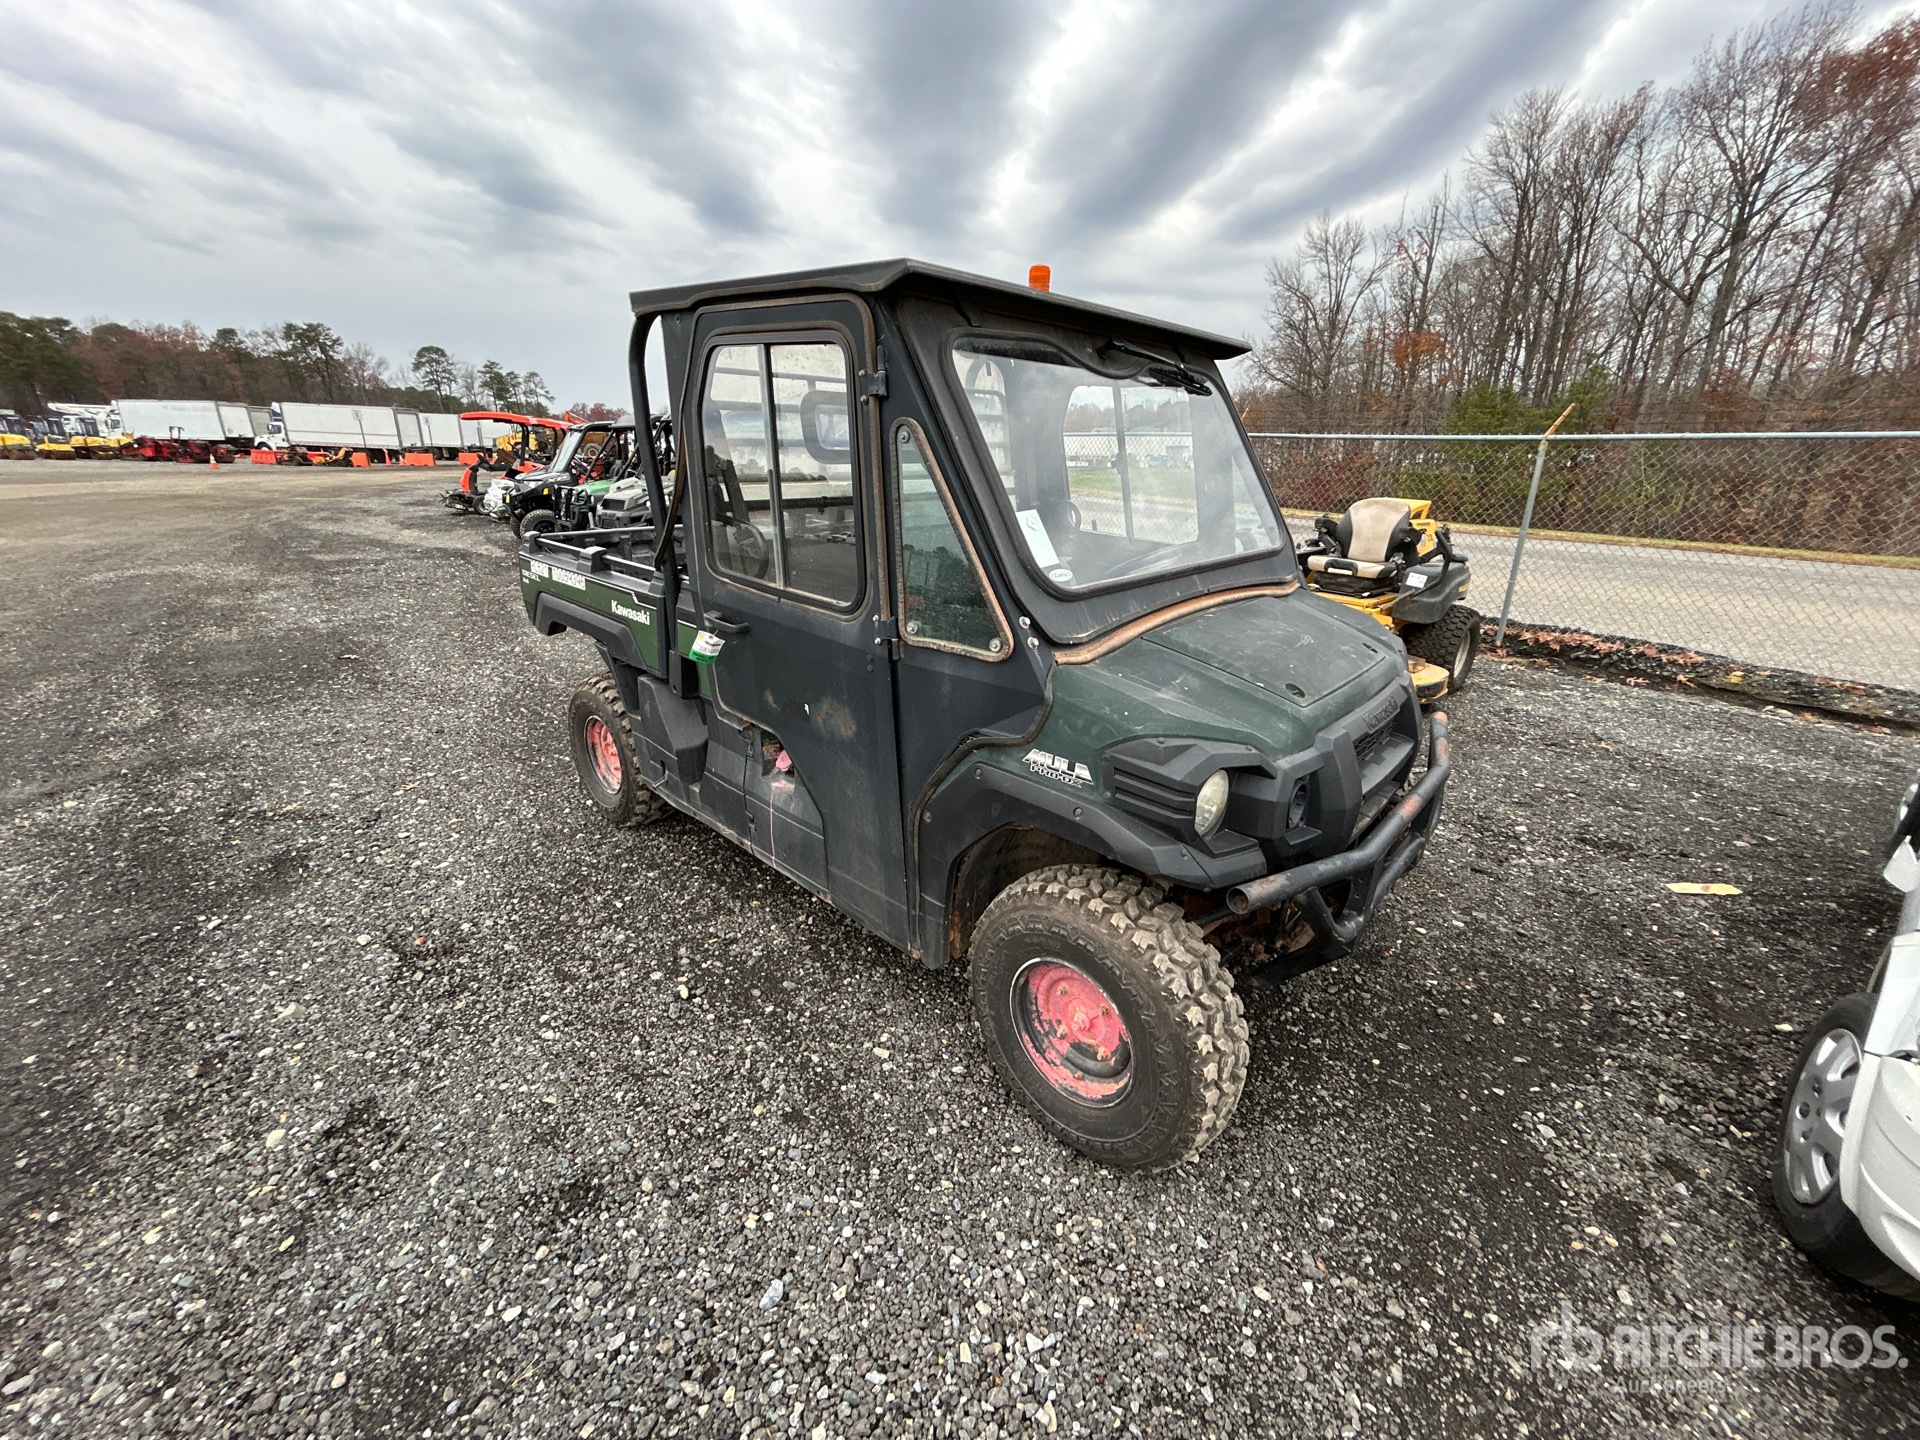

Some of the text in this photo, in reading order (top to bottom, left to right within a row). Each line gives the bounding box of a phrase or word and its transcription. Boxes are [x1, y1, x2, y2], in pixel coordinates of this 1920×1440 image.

[521, 569, 541, 582] DIESEL
[611, 599, 650, 626] Kawasaki
[1362, 694, 1400, 731] Kawasaki
[1022, 748, 1094, 785] MULE
